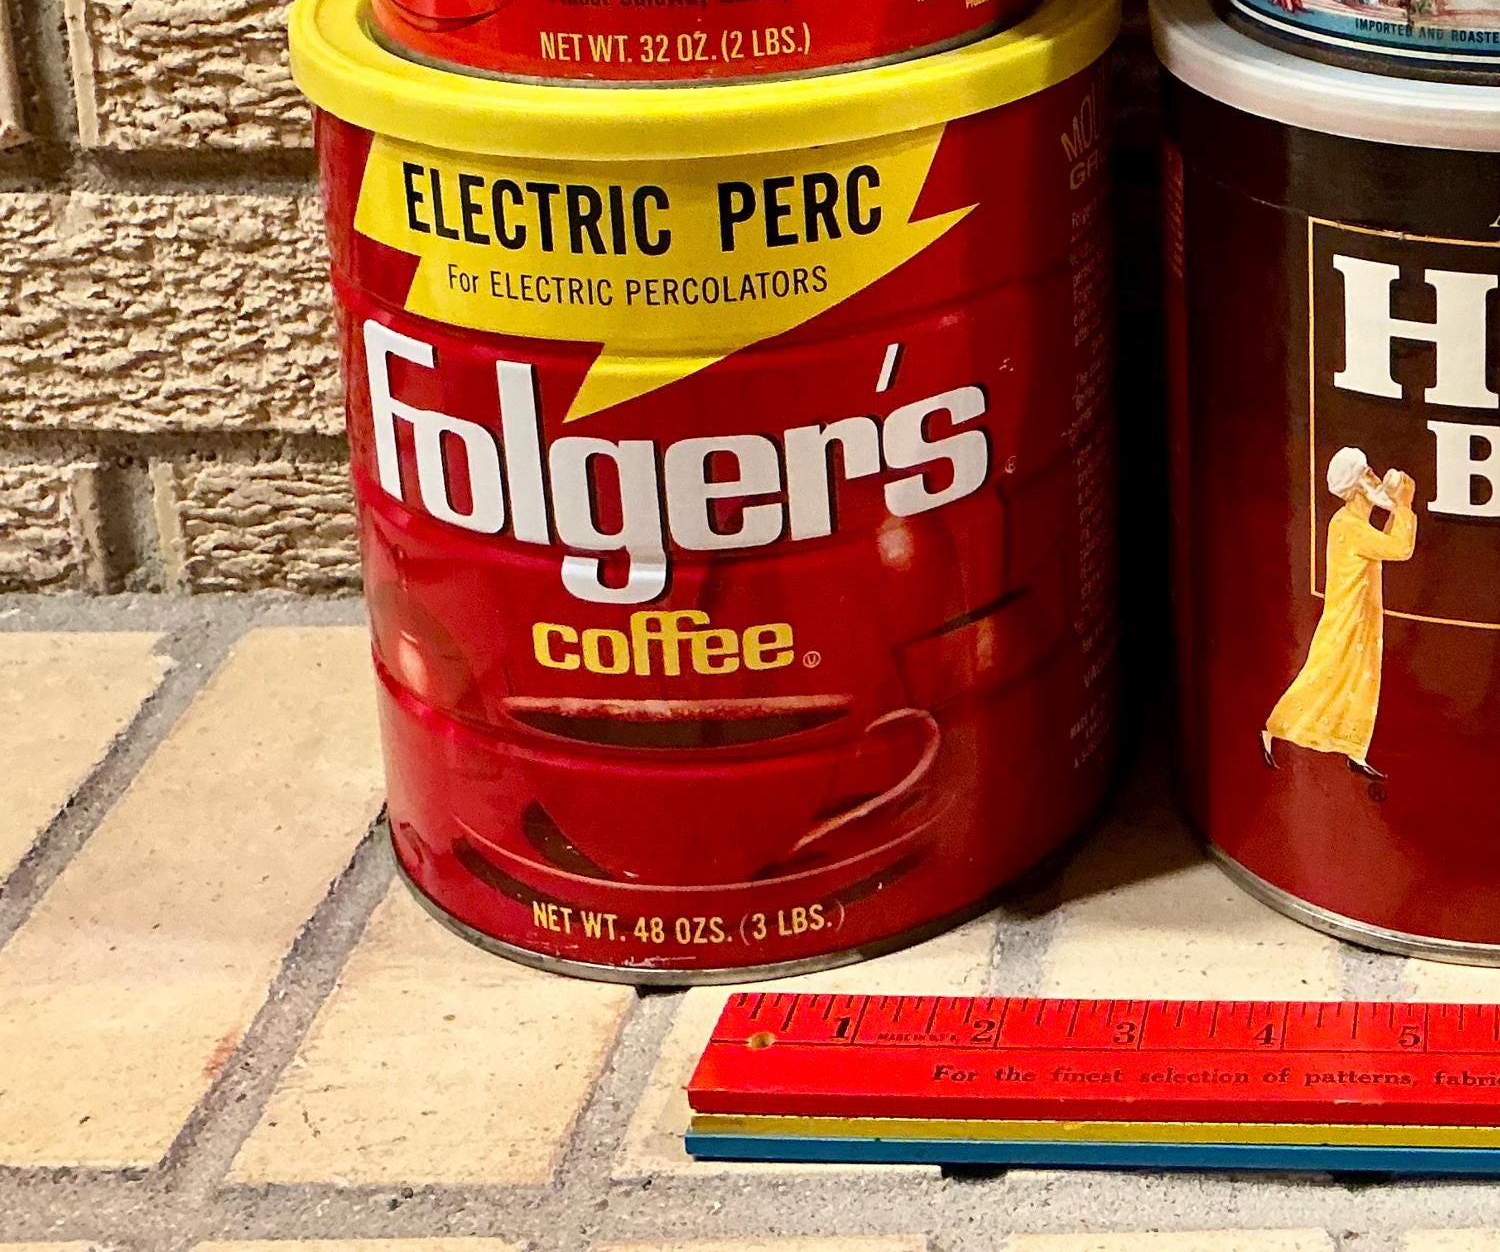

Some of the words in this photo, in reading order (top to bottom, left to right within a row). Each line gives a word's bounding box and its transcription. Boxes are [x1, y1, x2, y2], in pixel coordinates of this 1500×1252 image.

[1355, 17, 1413, 37] IMPORTED
[1419, 28, 1444, 40] AND
[540, 31, 582, 62] NET
[587, 34, 632, 63] WT.
[640, 35, 670, 63] 32
[677, 32, 717, 61] OZ.
[721, 30, 745, 63] (2
[752, 22, 811, 57] LBS.)
[402, 161, 673, 256] ELECTRIC
[719, 164, 883, 252] PERC
[448, 264, 479, 294] For
[491, 270, 613, 306] ELECTRIC
[626, 265, 828, 306] PERCOLATORS
[364, 319, 989, 605] Folger's
[532, 610, 795, 676] coffee
[533, 901, 572, 935] NET
[580, 911, 626, 942] WT.
[633, 917, 665, 943] 48
[675, 917, 733, 944] OZS.
[740, 913, 767, 946] (3
[777, 901, 845, 937] LBS.)
[829, 1016, 854, 1040] 1
[969, 1019, 996, 1043] 2
[1111, 1021, 1137, 1045] 3
[1253, 1021, 1277, 1046] 4
[1399, 1024, 1423, 1048] 5
[932, 1064, 978, 1083] For
[996, 1065, 1038, 1084] the
[1052, 1065, 1123, 1085] finest
[1140, 1066, 1249, 1086] selection
[1262, 1068, 1291, 1084] of
[1305, 1068, 1418, 1091] patterns,
